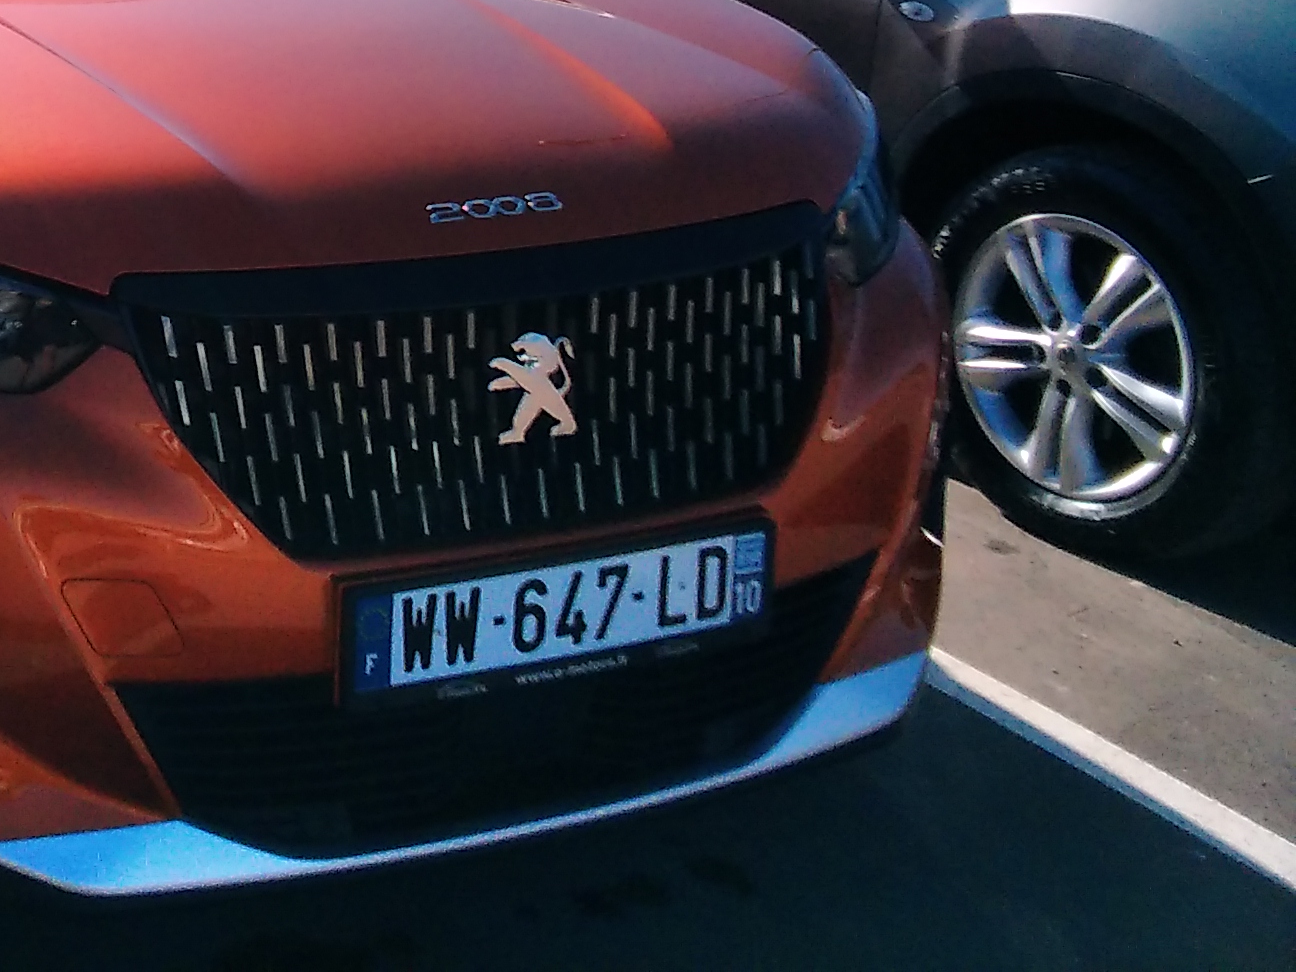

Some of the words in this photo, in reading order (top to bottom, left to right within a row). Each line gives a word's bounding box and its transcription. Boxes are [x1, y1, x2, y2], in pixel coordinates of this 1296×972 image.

[425, 191, 563, 224] 2008
[734, 580, 764, 615] 10
[364, 652, 379, 676] F
